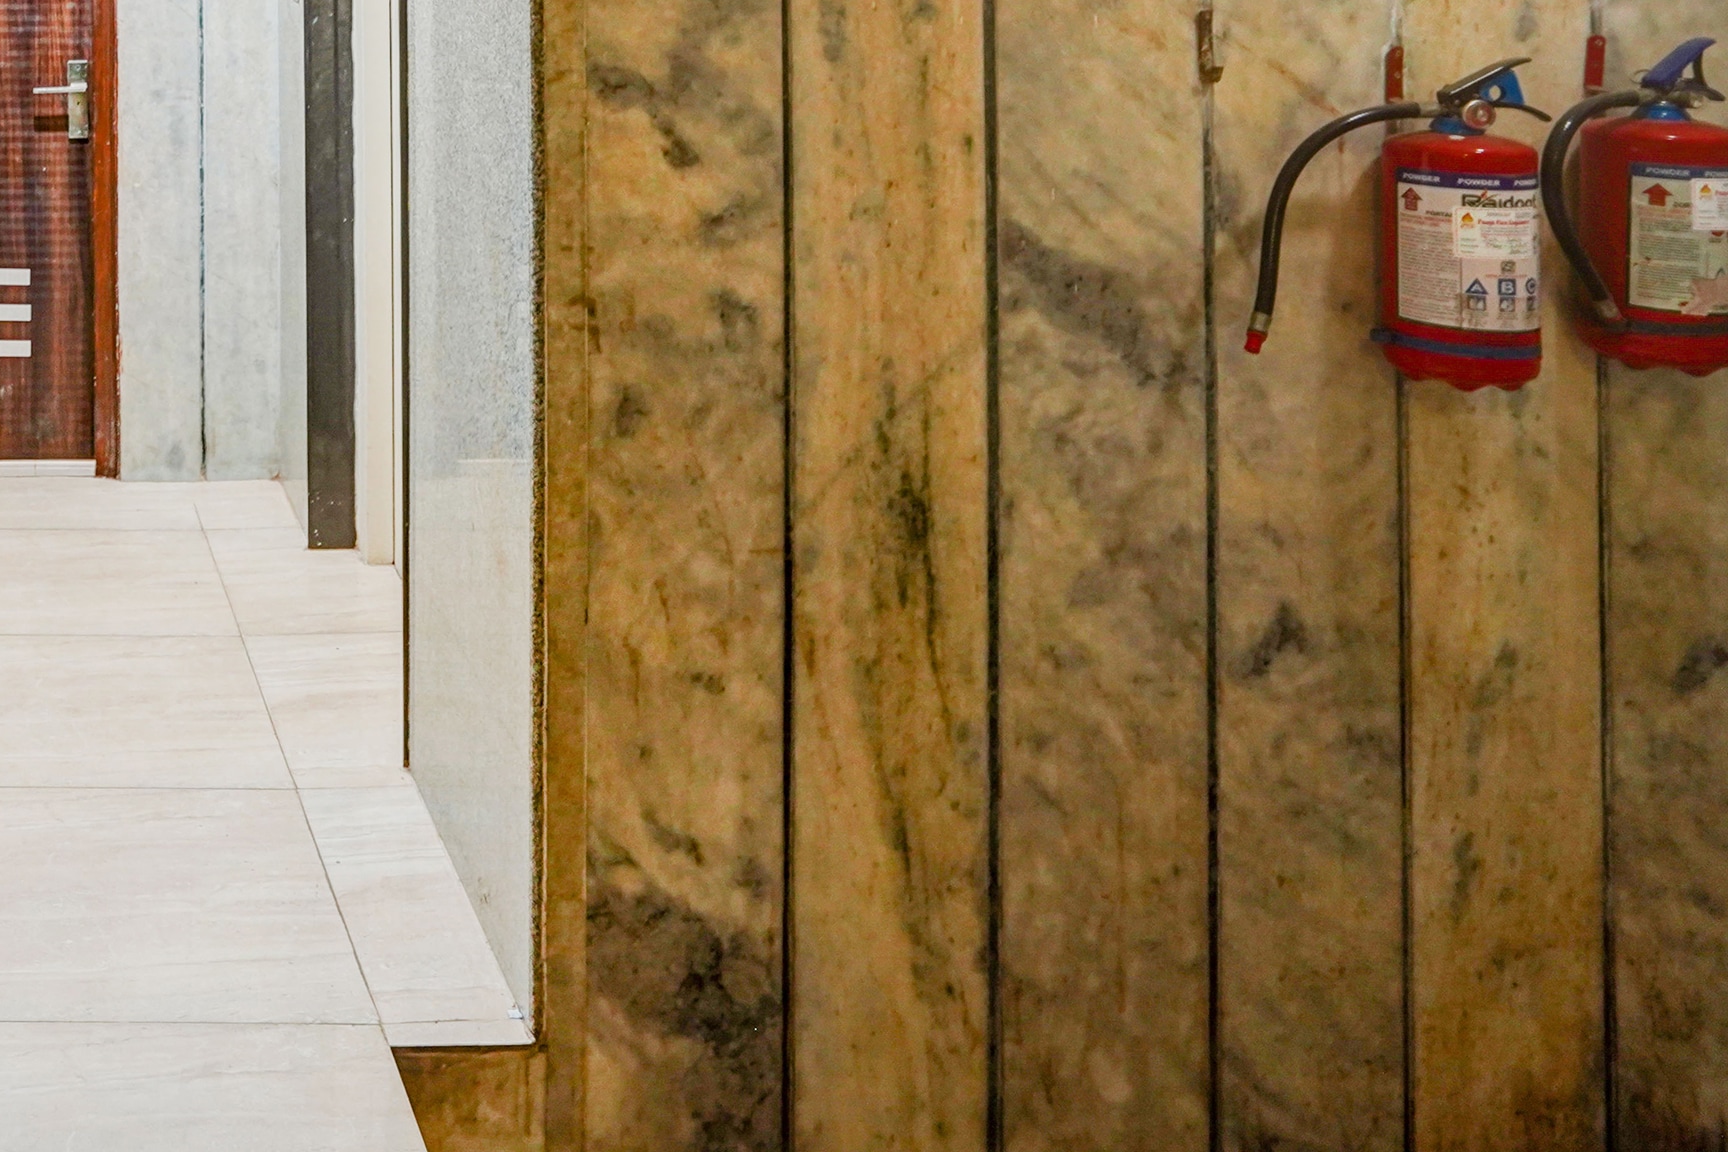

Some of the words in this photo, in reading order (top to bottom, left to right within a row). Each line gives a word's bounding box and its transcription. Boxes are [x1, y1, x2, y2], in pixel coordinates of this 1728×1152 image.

[1645, 167, 1690, 176] POWDER
[1402, 172, 1441, 183] POWDER
[1457, 177, 1501, 187] POWDER
[1470, 283, 1483, 293] A
[1501, 281, 1515, 294] B
